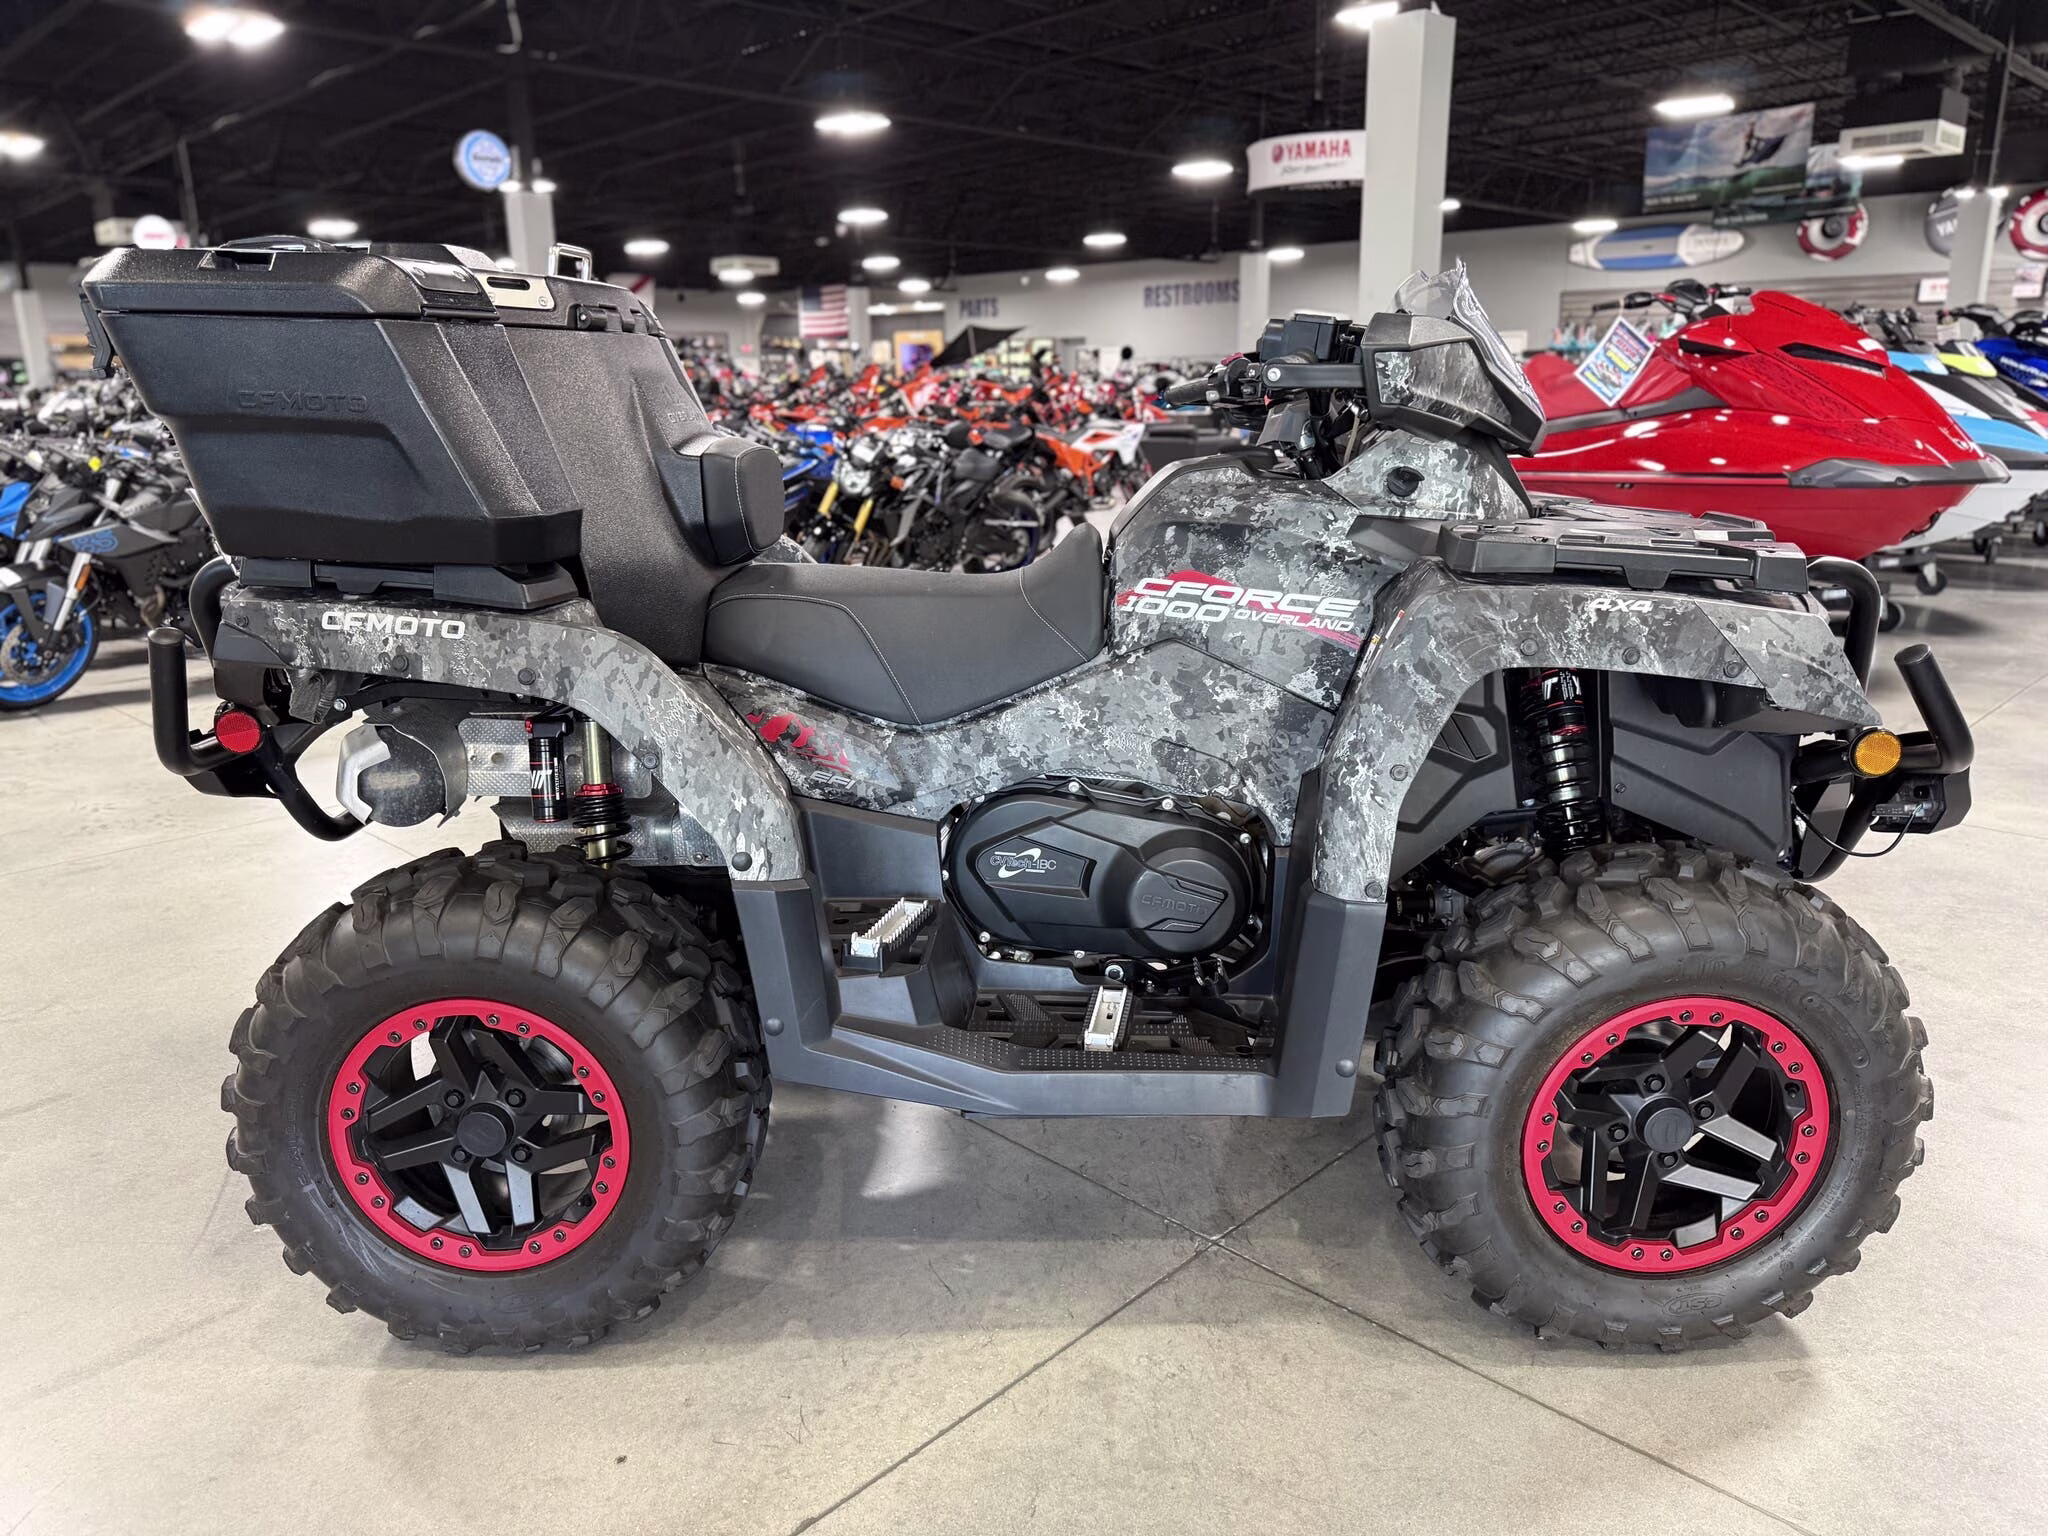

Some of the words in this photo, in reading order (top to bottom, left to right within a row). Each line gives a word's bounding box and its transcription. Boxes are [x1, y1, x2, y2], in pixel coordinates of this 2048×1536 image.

[1286, 139, 1351, 161] YAMAHA
[1144, 280, 1240, 308] RESTROOMS
[959, 299, 999, 319] PARTS
[238, 390, 368, 413] CFMOTO
[1133, 577, 1361, 618] CFORCE
[321, 610, 466, 640] CFMOTO
[1119, 595, 1230, 622] 1000
[1233, 608, 1355, 632] OVERLAND
[809, 769, 857, 790] EFI
[1140, 894, 1208, 916] CFMOTO
